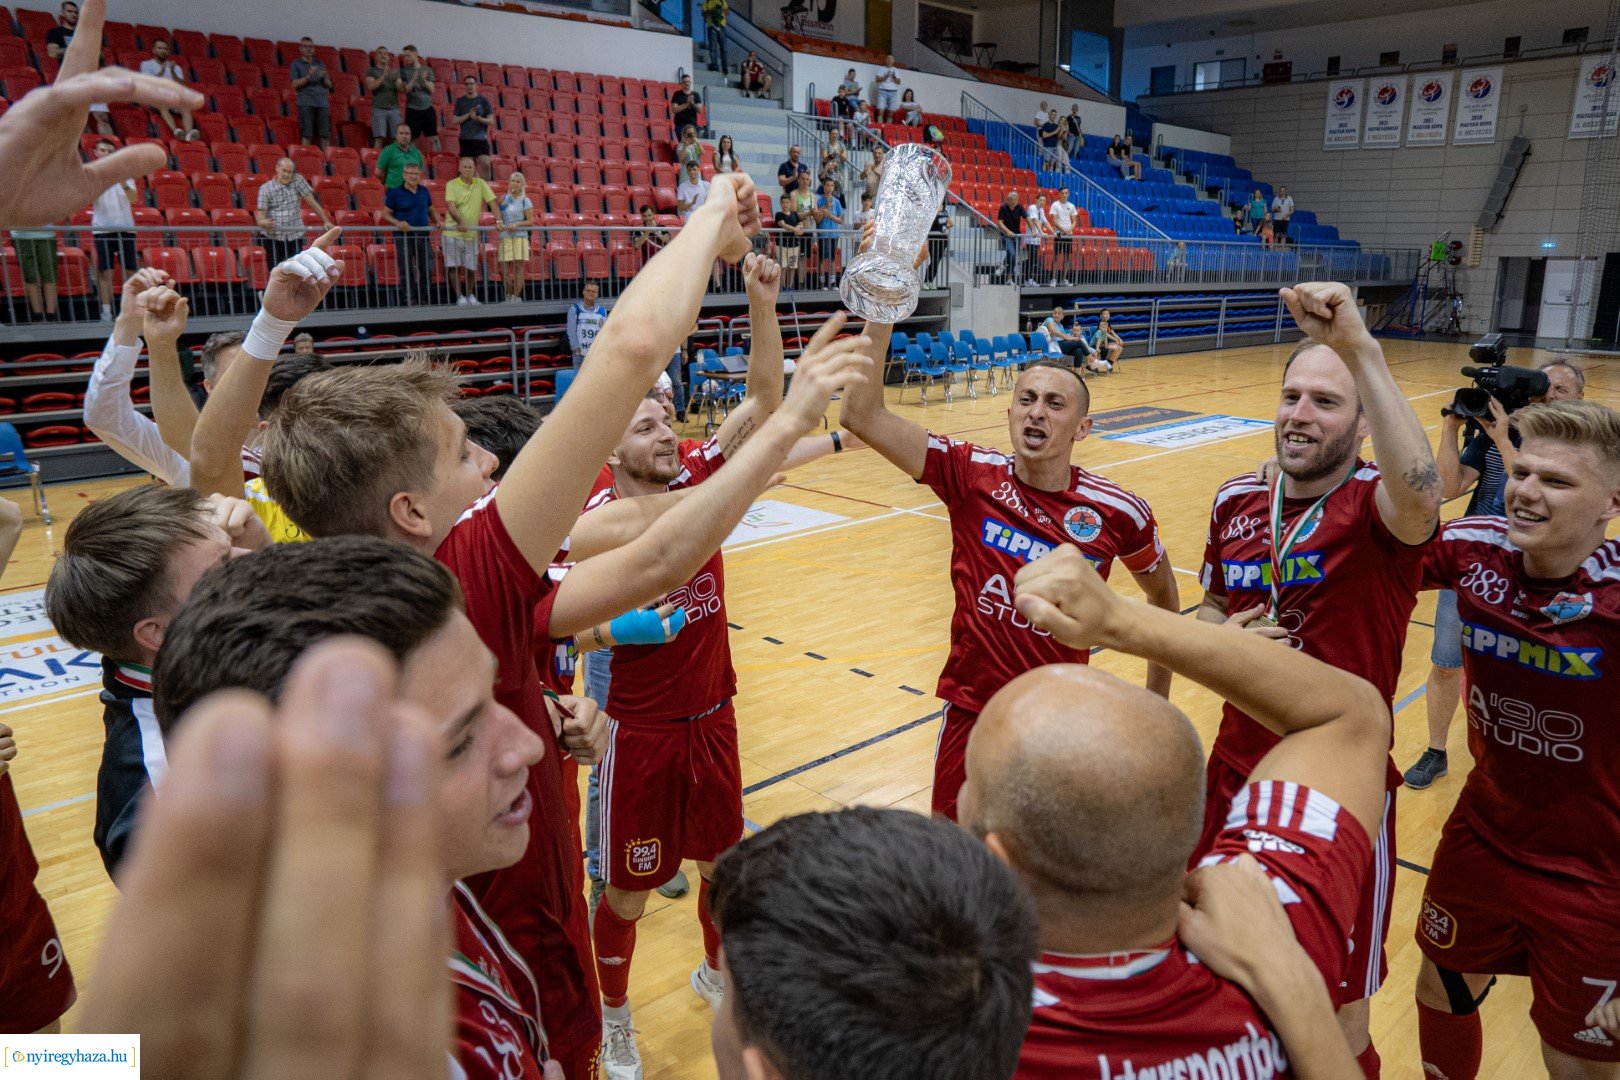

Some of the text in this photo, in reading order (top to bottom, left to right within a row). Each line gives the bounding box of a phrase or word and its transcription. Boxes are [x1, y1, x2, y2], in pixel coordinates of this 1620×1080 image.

[1460, 562, 1508, 605] 383
[685, 596, 721, 624] DIO
[1469, 708, 1584, 763] STUDIO
[632, 843, 657, 858] 99.4
[638, 861, 652, 871] FM
[41, 938, 63, 979] 9
[1582, 976, 1617, 1017] 7
